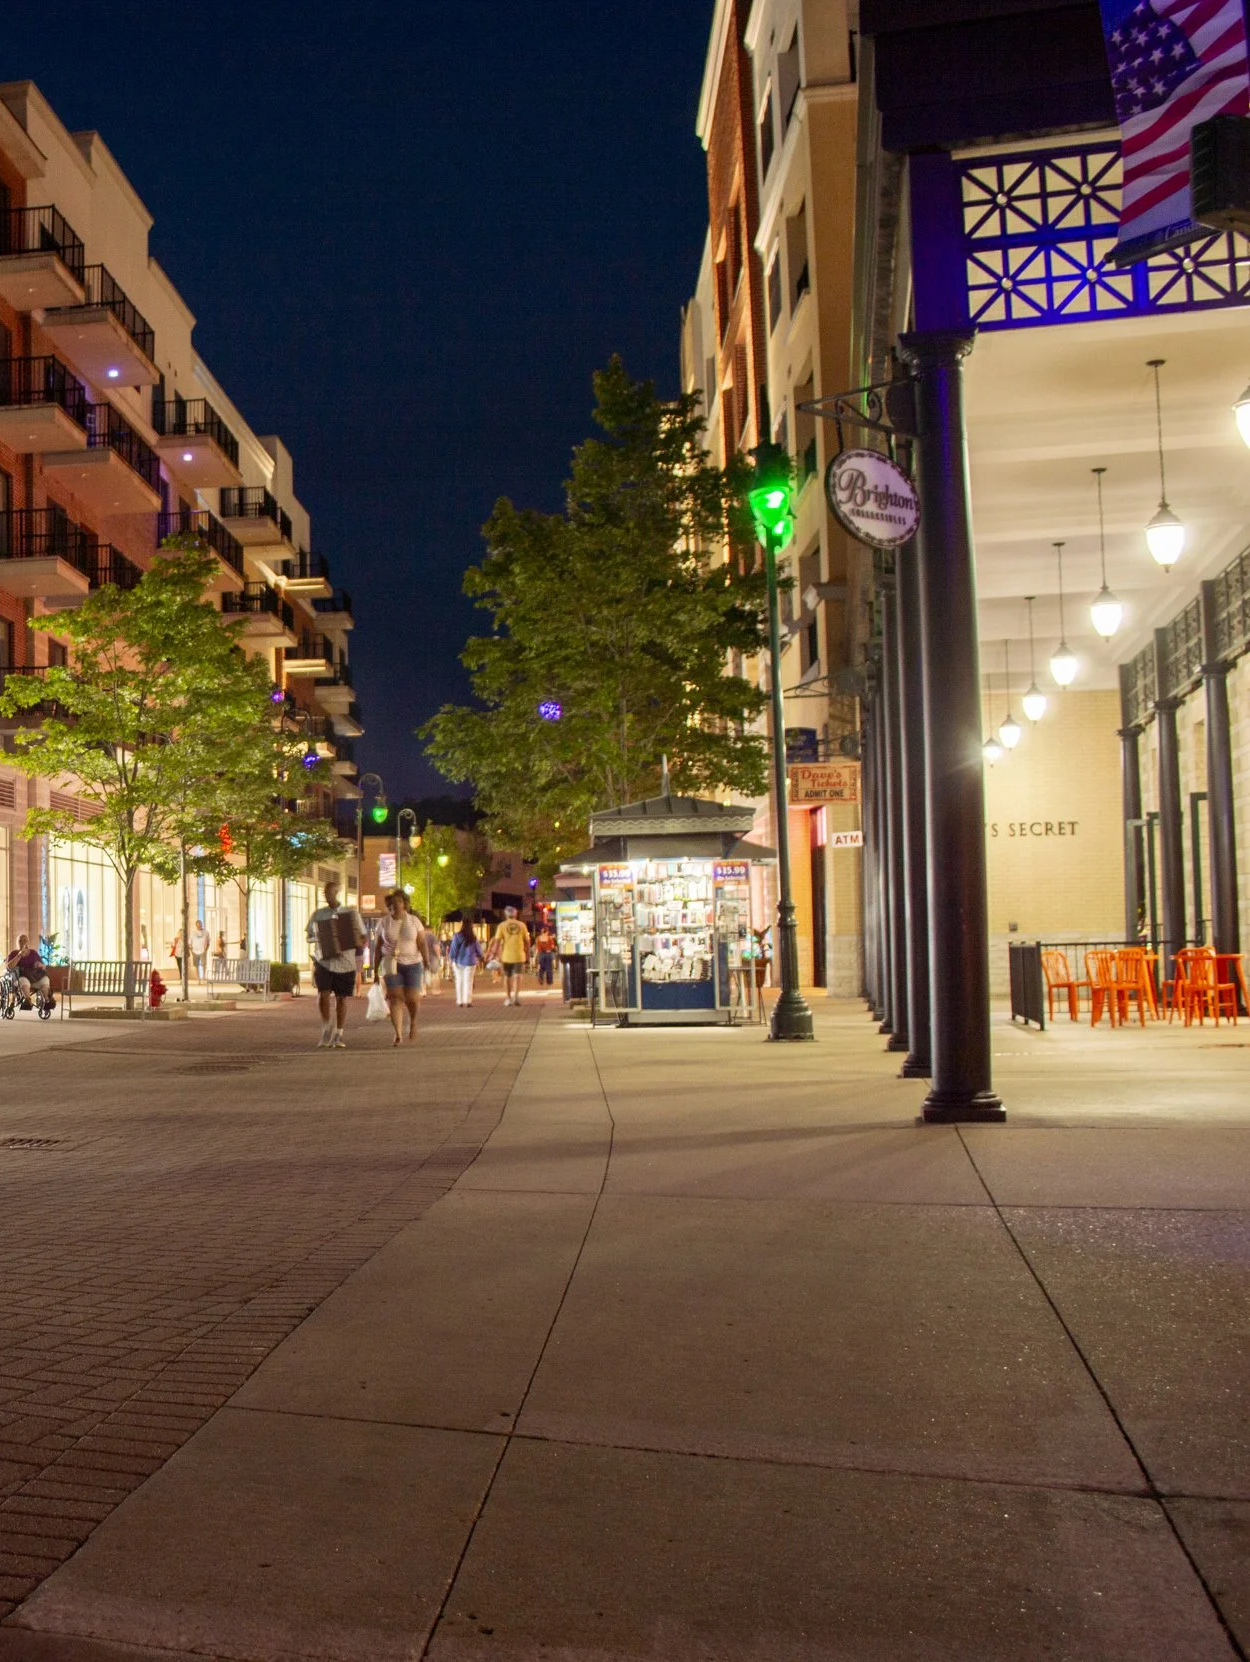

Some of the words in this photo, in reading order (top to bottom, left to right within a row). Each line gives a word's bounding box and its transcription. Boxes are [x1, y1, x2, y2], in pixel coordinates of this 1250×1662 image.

[838, 468, 914, 511] Brighton
[804, 789, 828, 799] ADMIT
[829, 788, 845, 798] ONE
[1008, 820, 1080, 837] SECRET
[835, 834, 860, 846] ATM
